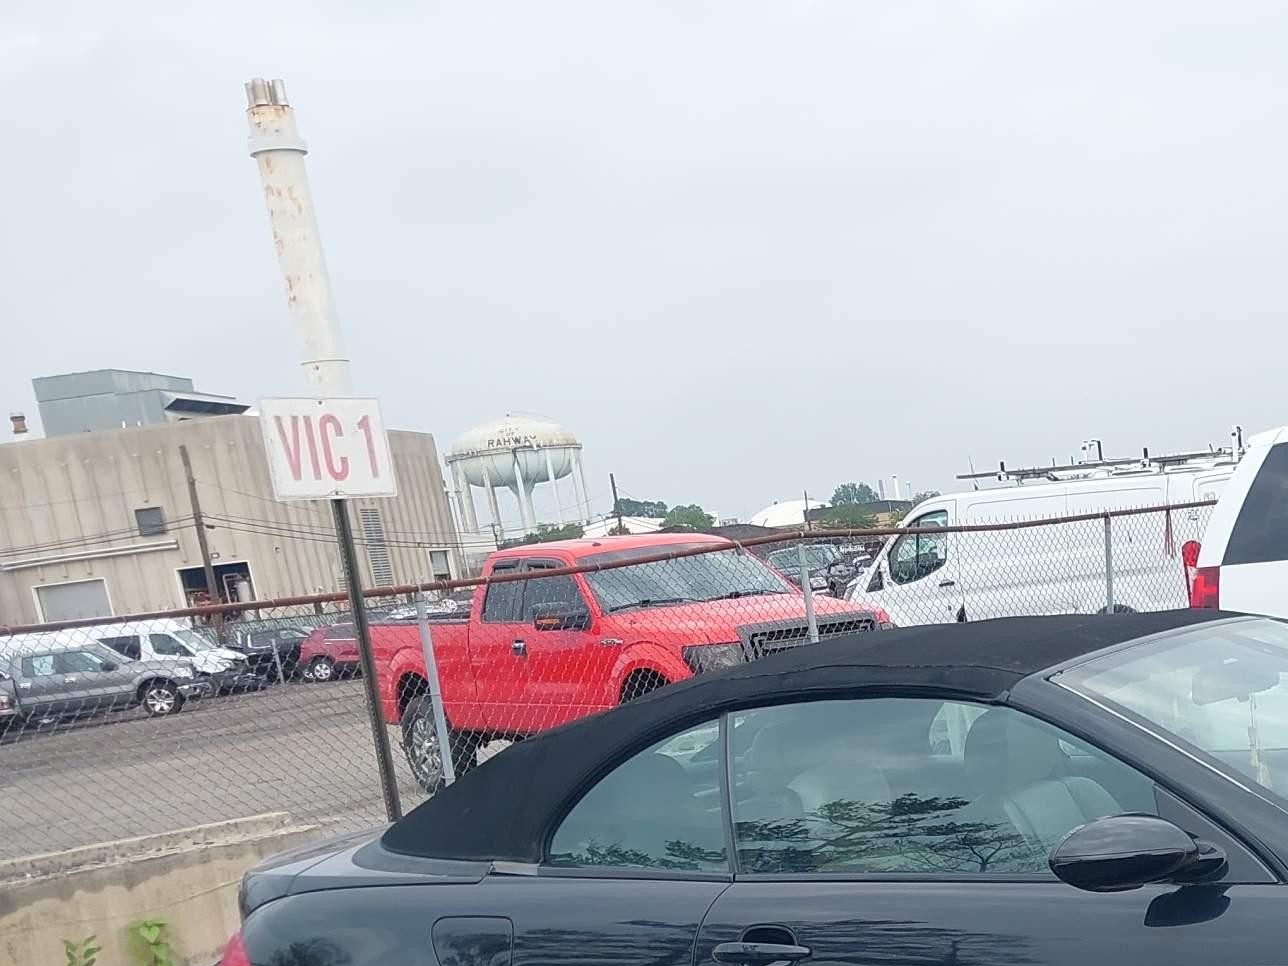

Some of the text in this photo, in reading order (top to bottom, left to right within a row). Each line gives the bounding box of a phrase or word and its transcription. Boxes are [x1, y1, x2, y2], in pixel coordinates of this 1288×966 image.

[273, 413, 380, 481] VIC 1
[487, 434, 537, 448] RAHWAY
